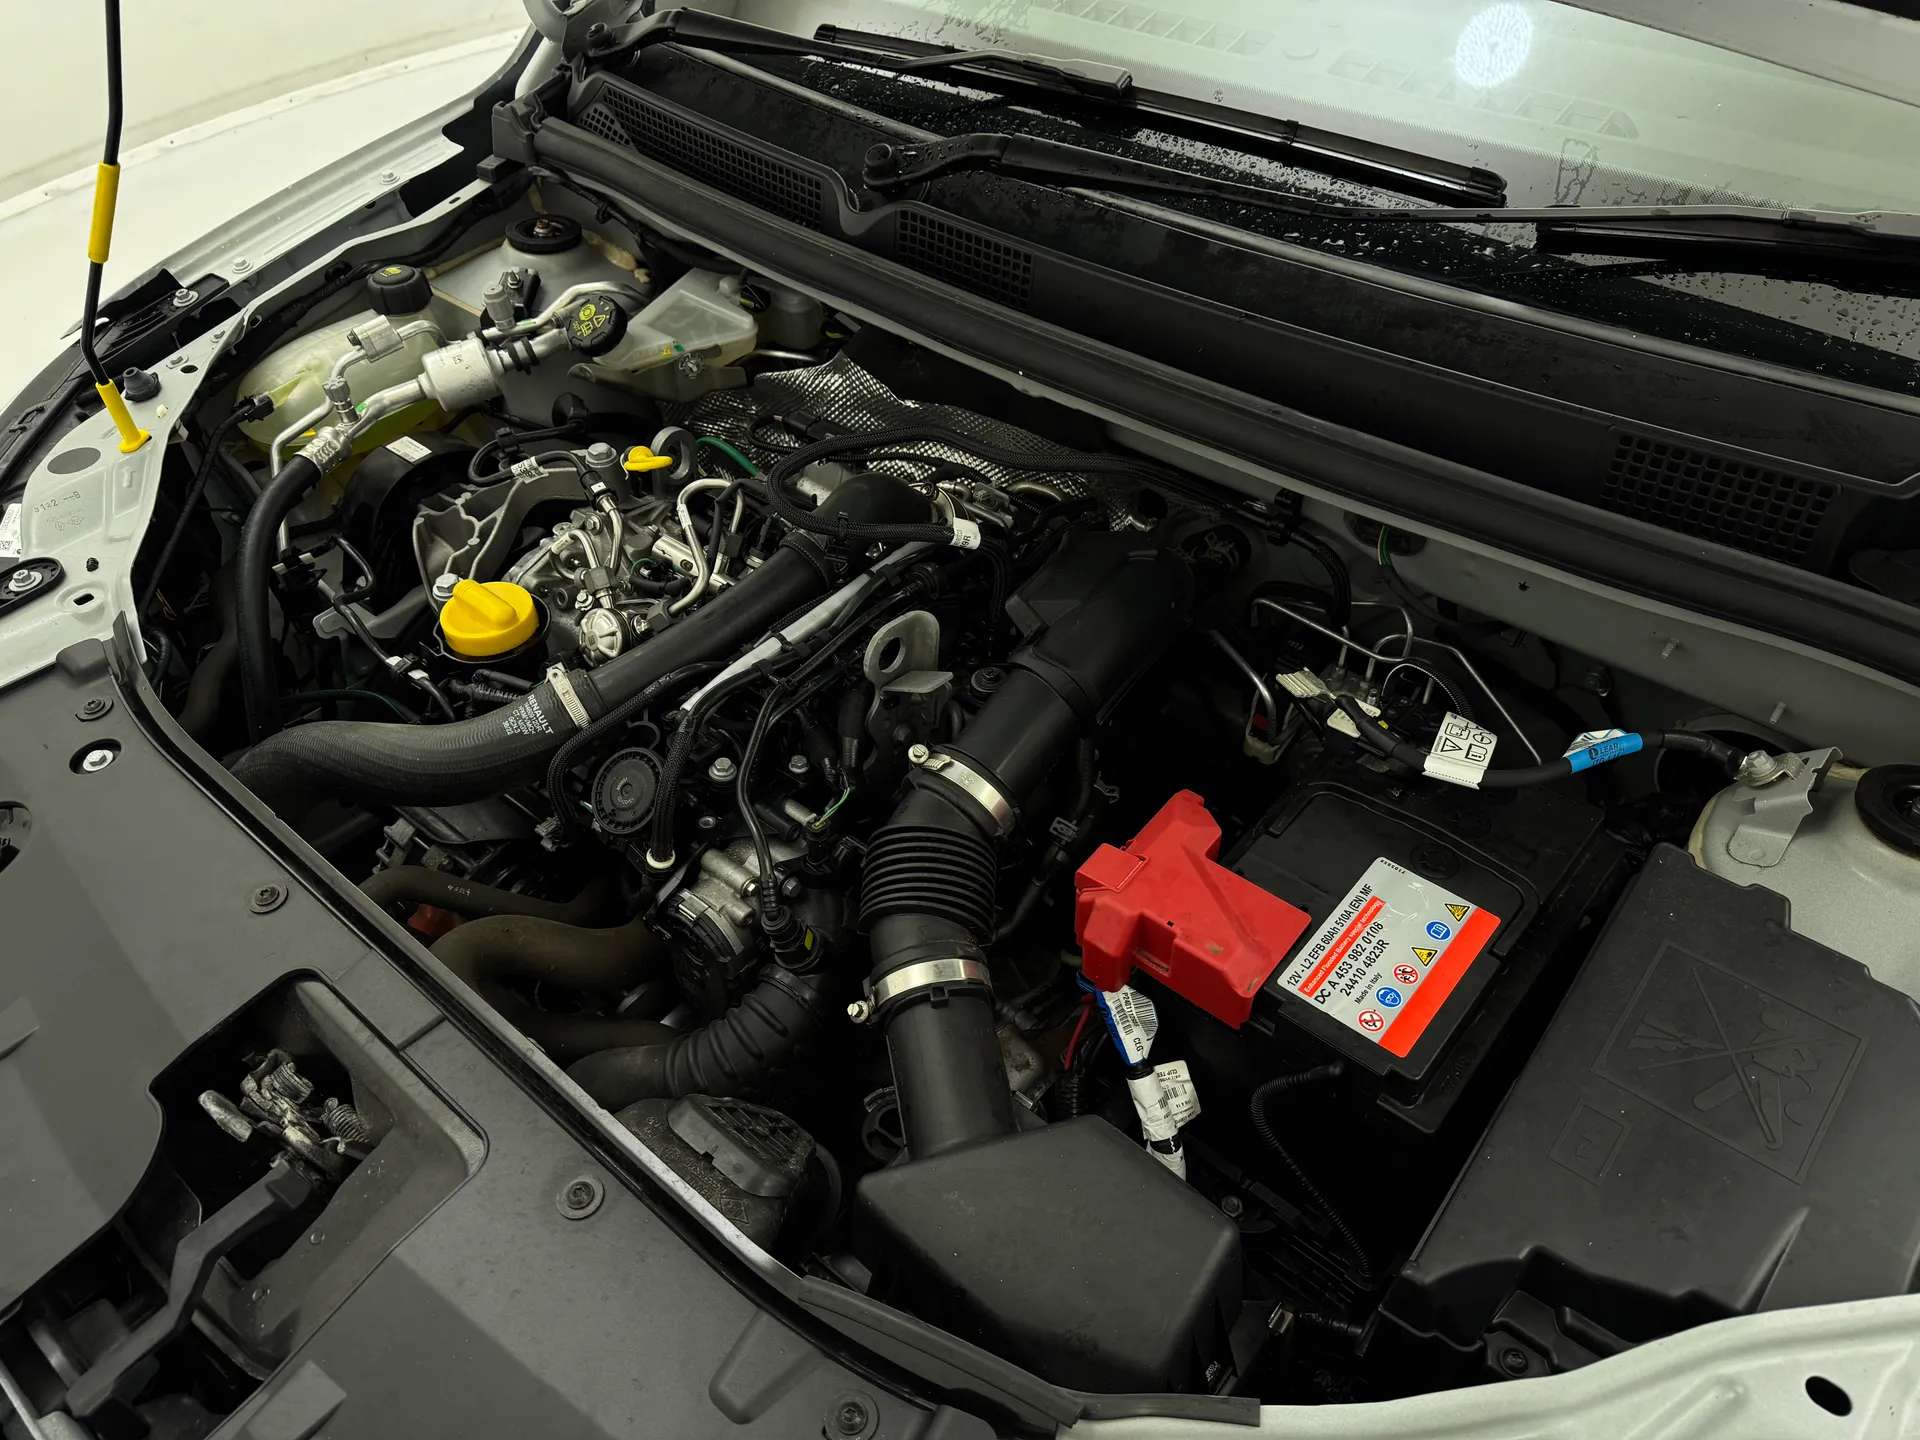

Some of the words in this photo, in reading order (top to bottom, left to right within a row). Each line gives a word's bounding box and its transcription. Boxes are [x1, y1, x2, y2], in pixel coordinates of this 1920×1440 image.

[527, 694, 554, 734] RENAULT
[1287, 971, 1302, 986] 12V
[1300, 958, 1314, 970] L2
[1308, 943, 1326, 960] EFB
[1321, 926, 1341, 945] 60Ah
[1335, 909, 1354, 927] 510A
[1348, 895, 1367, 912] (EN)
[1360, 884, 1372, 896] MF
[1314, 989, 1331, 1004] DC
[1328, 979, 1340, 990] A
[1335, 961, 1353, 979] 453
[1348, 943, 1367, 961] 982
[1362, 922, 1384, 944] 0108
[1340, 967, 1366, 996] 24410
[1363, 939, 1390, 969] 4823R
[1354, 989, 1369, 1004] Made
[1371, 972, 1383, 987] Italy
